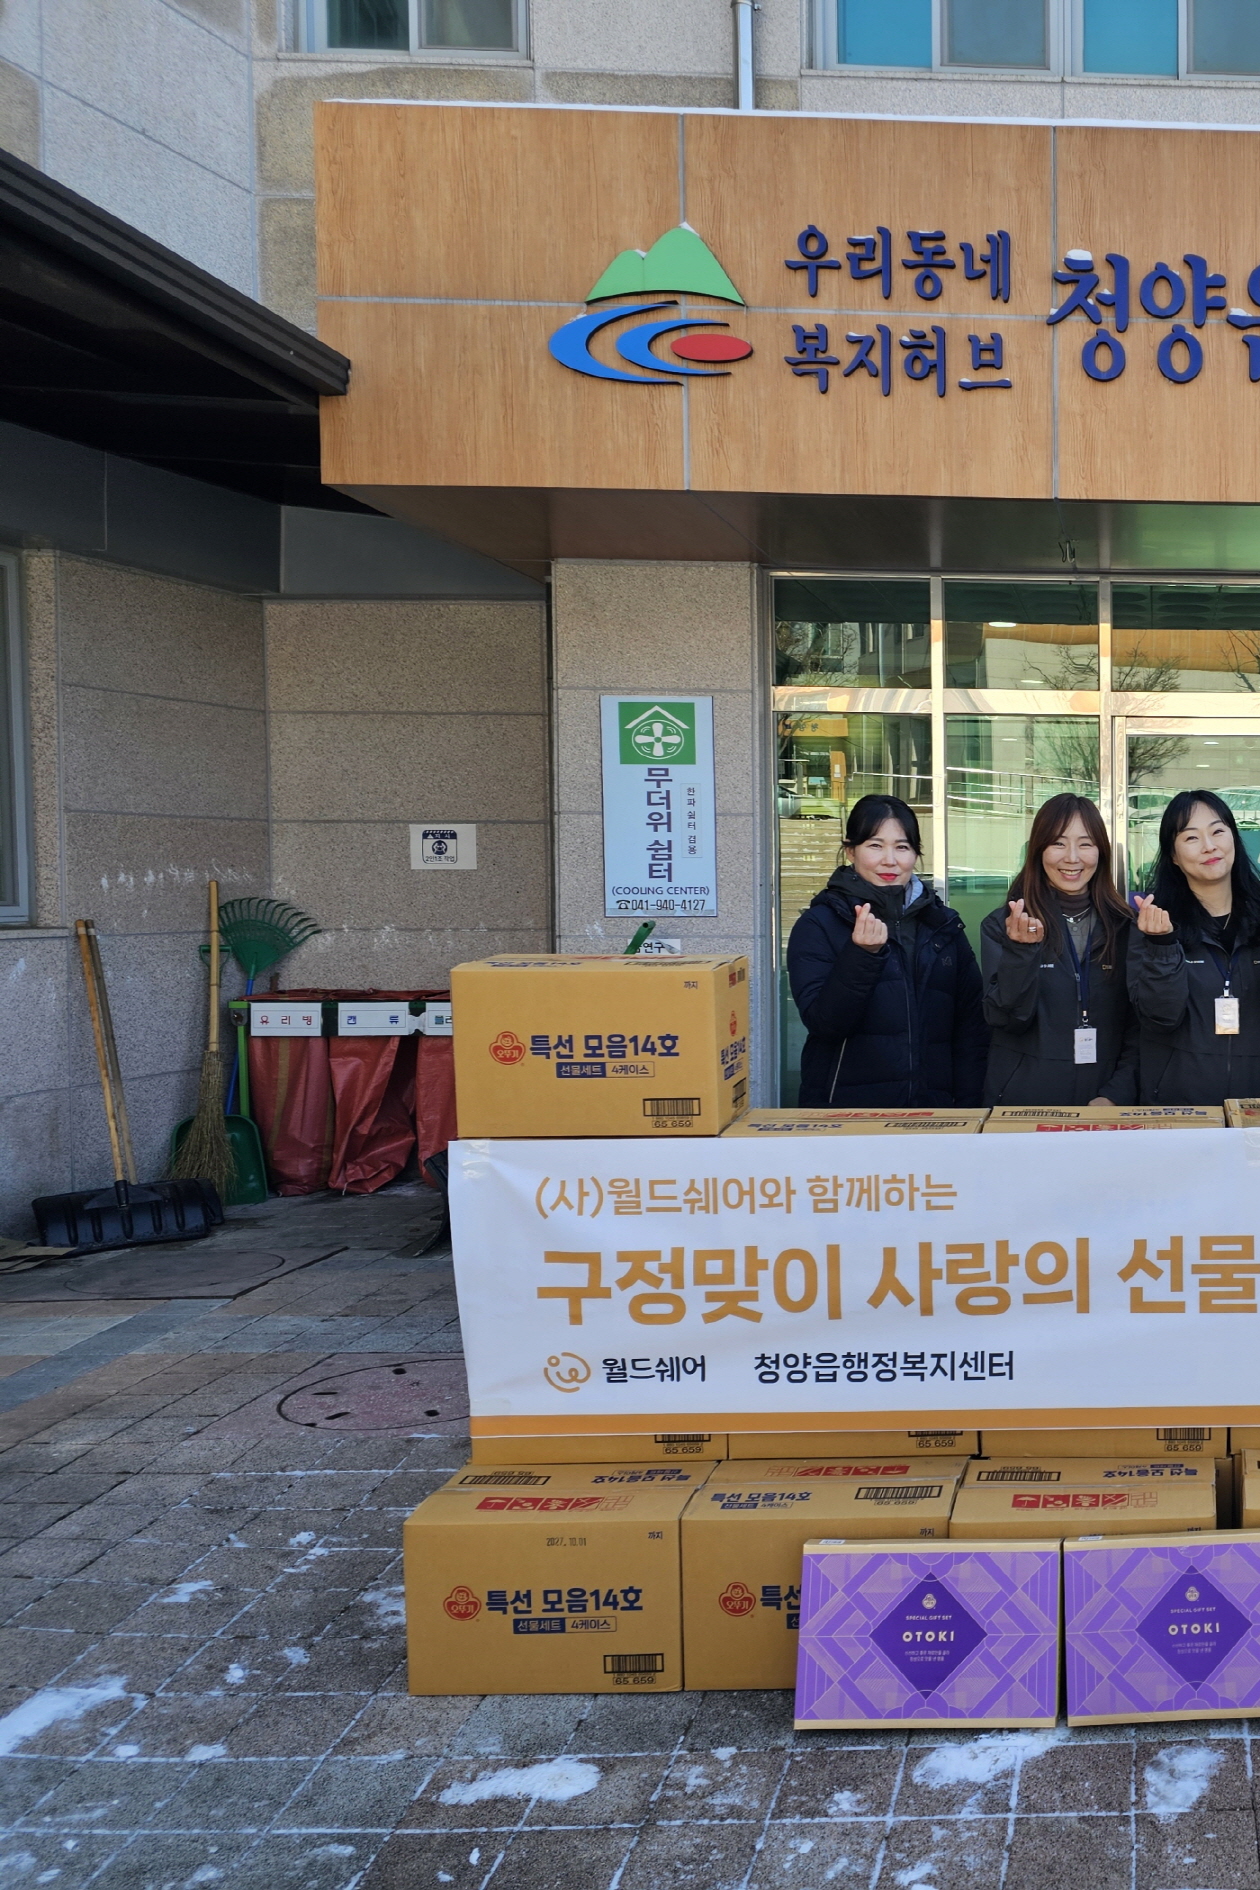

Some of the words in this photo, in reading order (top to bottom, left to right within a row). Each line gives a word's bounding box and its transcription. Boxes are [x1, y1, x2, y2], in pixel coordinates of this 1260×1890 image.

[785, 225, 1010, 303] 우리동네
[785, 324, 1012, 397] 복지허브
[644, 768, 673, 833] 무더위
[646, 840, 673, 882] 쉼터
[612, 886, 664, 896] (COOLING
[666, 886, 710, 896] CENTER)
[631, 899, 706, 911] 041-940-4127
[684, 981, 698, 989] 까지
[529, 1035, 575, 1059] 특선
[583, 1033, 680, 1059] 모음14호
[561, 1065, 602, 1076] 선물세트
[612, 1065, 649, 1075] 4케이스
[535, 1175, 797, 1220] (사)월드쉐어와
[807, 1174, 958, 1214] 함께하는
[537, 1244, 842, 1326] 구정맞이
[867, 1237, 1090, 1317] 사랑의
[601, 1355, 706, 1384] 월드쉐어
[754, 1351, 1015, 1384] 청양읍행정복지센터
[665, 1446, 678, 1454] 65
[681, 1446, 702, 1454] 659
[918, 1440, 931, 1448] 65
[1183, 1444, 1202, 1452] 659
[711, 1493, 742, 1502] 특선
[745, 1492, 812, 1502] 모음14호
[648, 1531, 663, 1539] 까지
[920, 1528, 934, 1537] 까지
[486, 1589, 532, 1615] 특선
[541, 1586, 643, 1614] 모음14호
[760, 1585, 801, 1610] 특선
[517, 1619, 561, 1631] 선물세트
[571, 1619, 611, 1630] 4케이스
[1168, 1622, 1220, 1635] OTOKI
[902, 1631, 954, 1642] OTOKI
[615, 1677, 629, 1685] 65
[633, 1677, 654, 1685] 659
